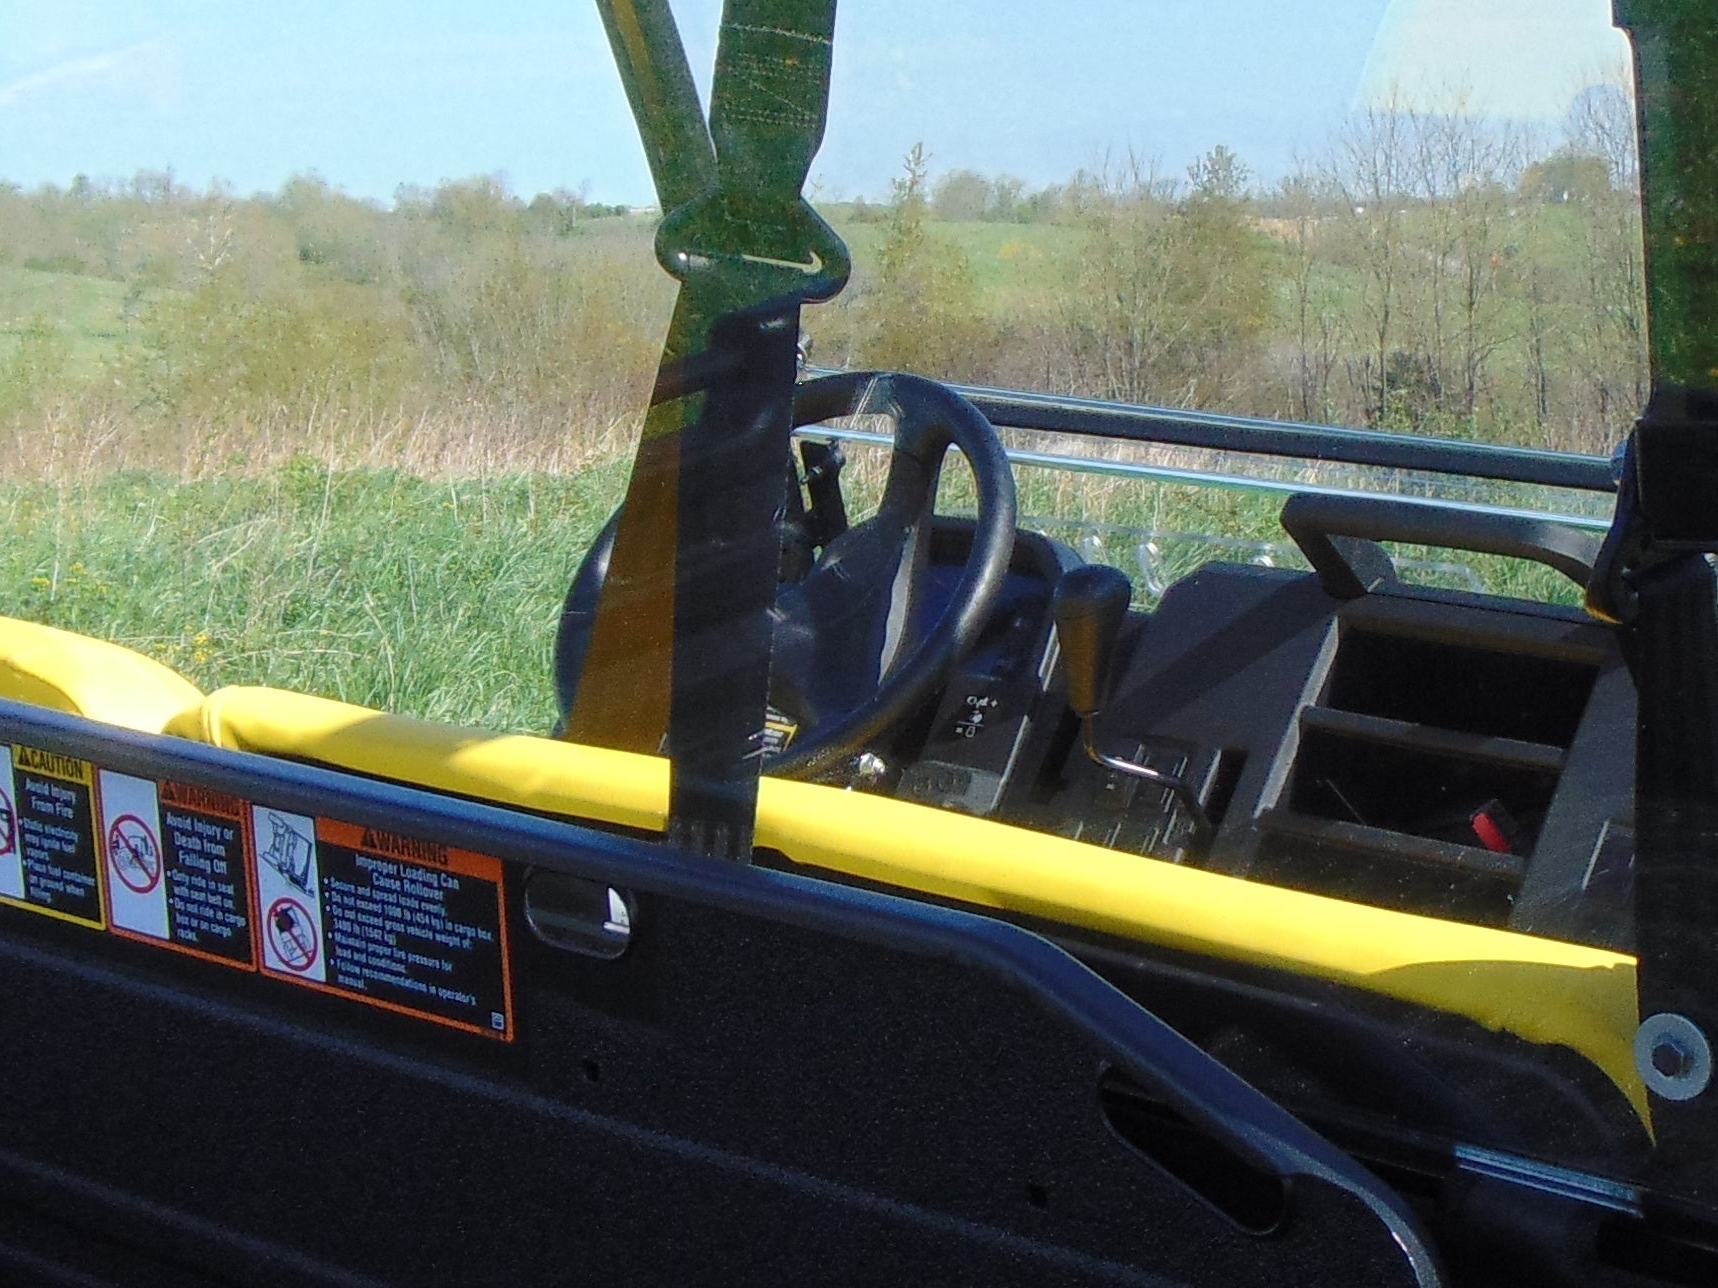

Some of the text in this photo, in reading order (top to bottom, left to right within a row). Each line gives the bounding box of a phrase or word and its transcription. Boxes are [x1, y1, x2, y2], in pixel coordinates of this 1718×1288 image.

[32, 751, 83, 779] CAUTION
[167, 812, 233, 840] Avoid Injury or
[174, 831, 225, 856] Death from
[372, 829, 447, 865] WARNING
[179, 850, 227, 874] Falling Off
[356, 854, 459, 889] Improper Loading Can
[357, 887, 370, 896] and
[373, 873, 443, 900] Cause Rollover
[332, 891, 341, 903] Do
[343, 896, 355, 906] not
[356, 900, 382, 913] exceed
[454, 924, 476, 937] cargo
[332, 905, 342, 917] Do
[344, 910, 355, 919] not
[358, 913, 383, 926] exceed
[385, 920, 405, 932] gross
[407, 926, 433, 940] vehicle
[435, 933, 460, 947] weight
[335, 932, 366, 948] Maintain
[368, 943, 392, 955] proper
[408, 953, 439, 968] pressure
[362, 968, 427, 992] recommendations
